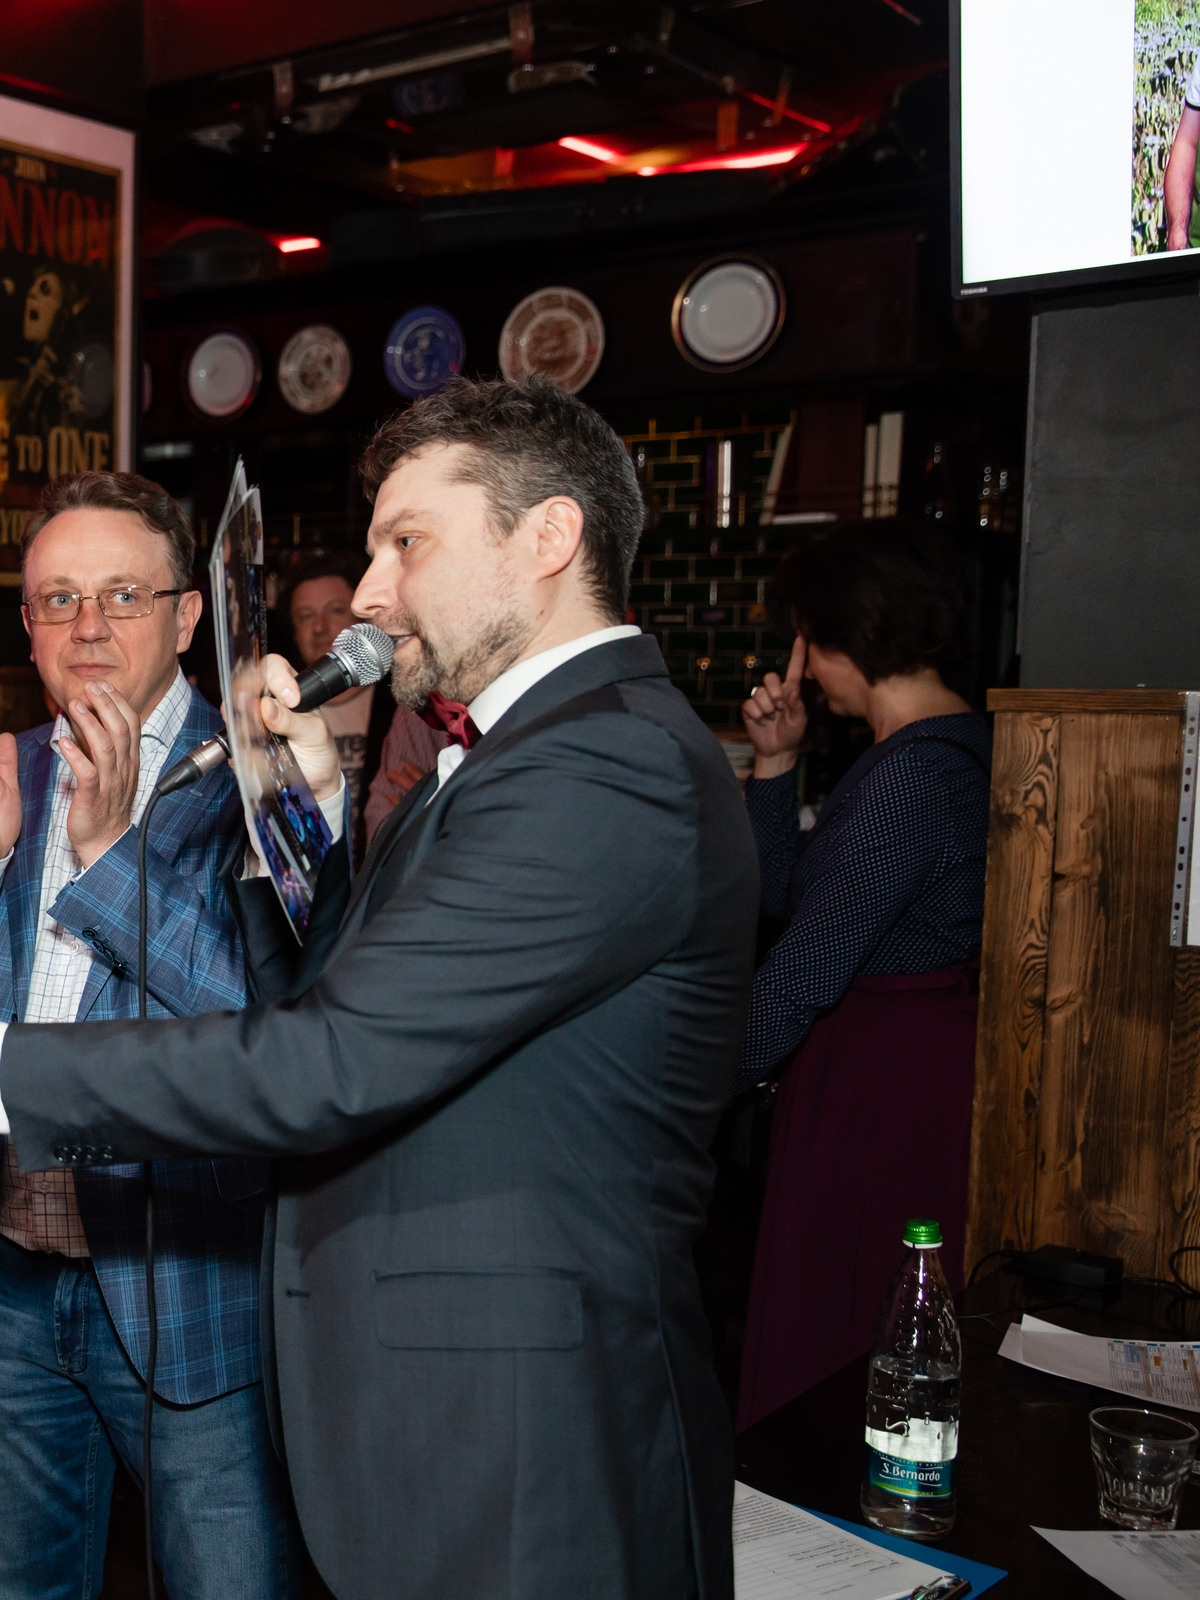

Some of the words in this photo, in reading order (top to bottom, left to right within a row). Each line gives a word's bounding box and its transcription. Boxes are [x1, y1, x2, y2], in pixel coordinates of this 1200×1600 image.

[15, 432, 43, 473] TO
[49, 426, 110, 480] ONE
[881, 1462, 941, 1482] S.Bernardo
